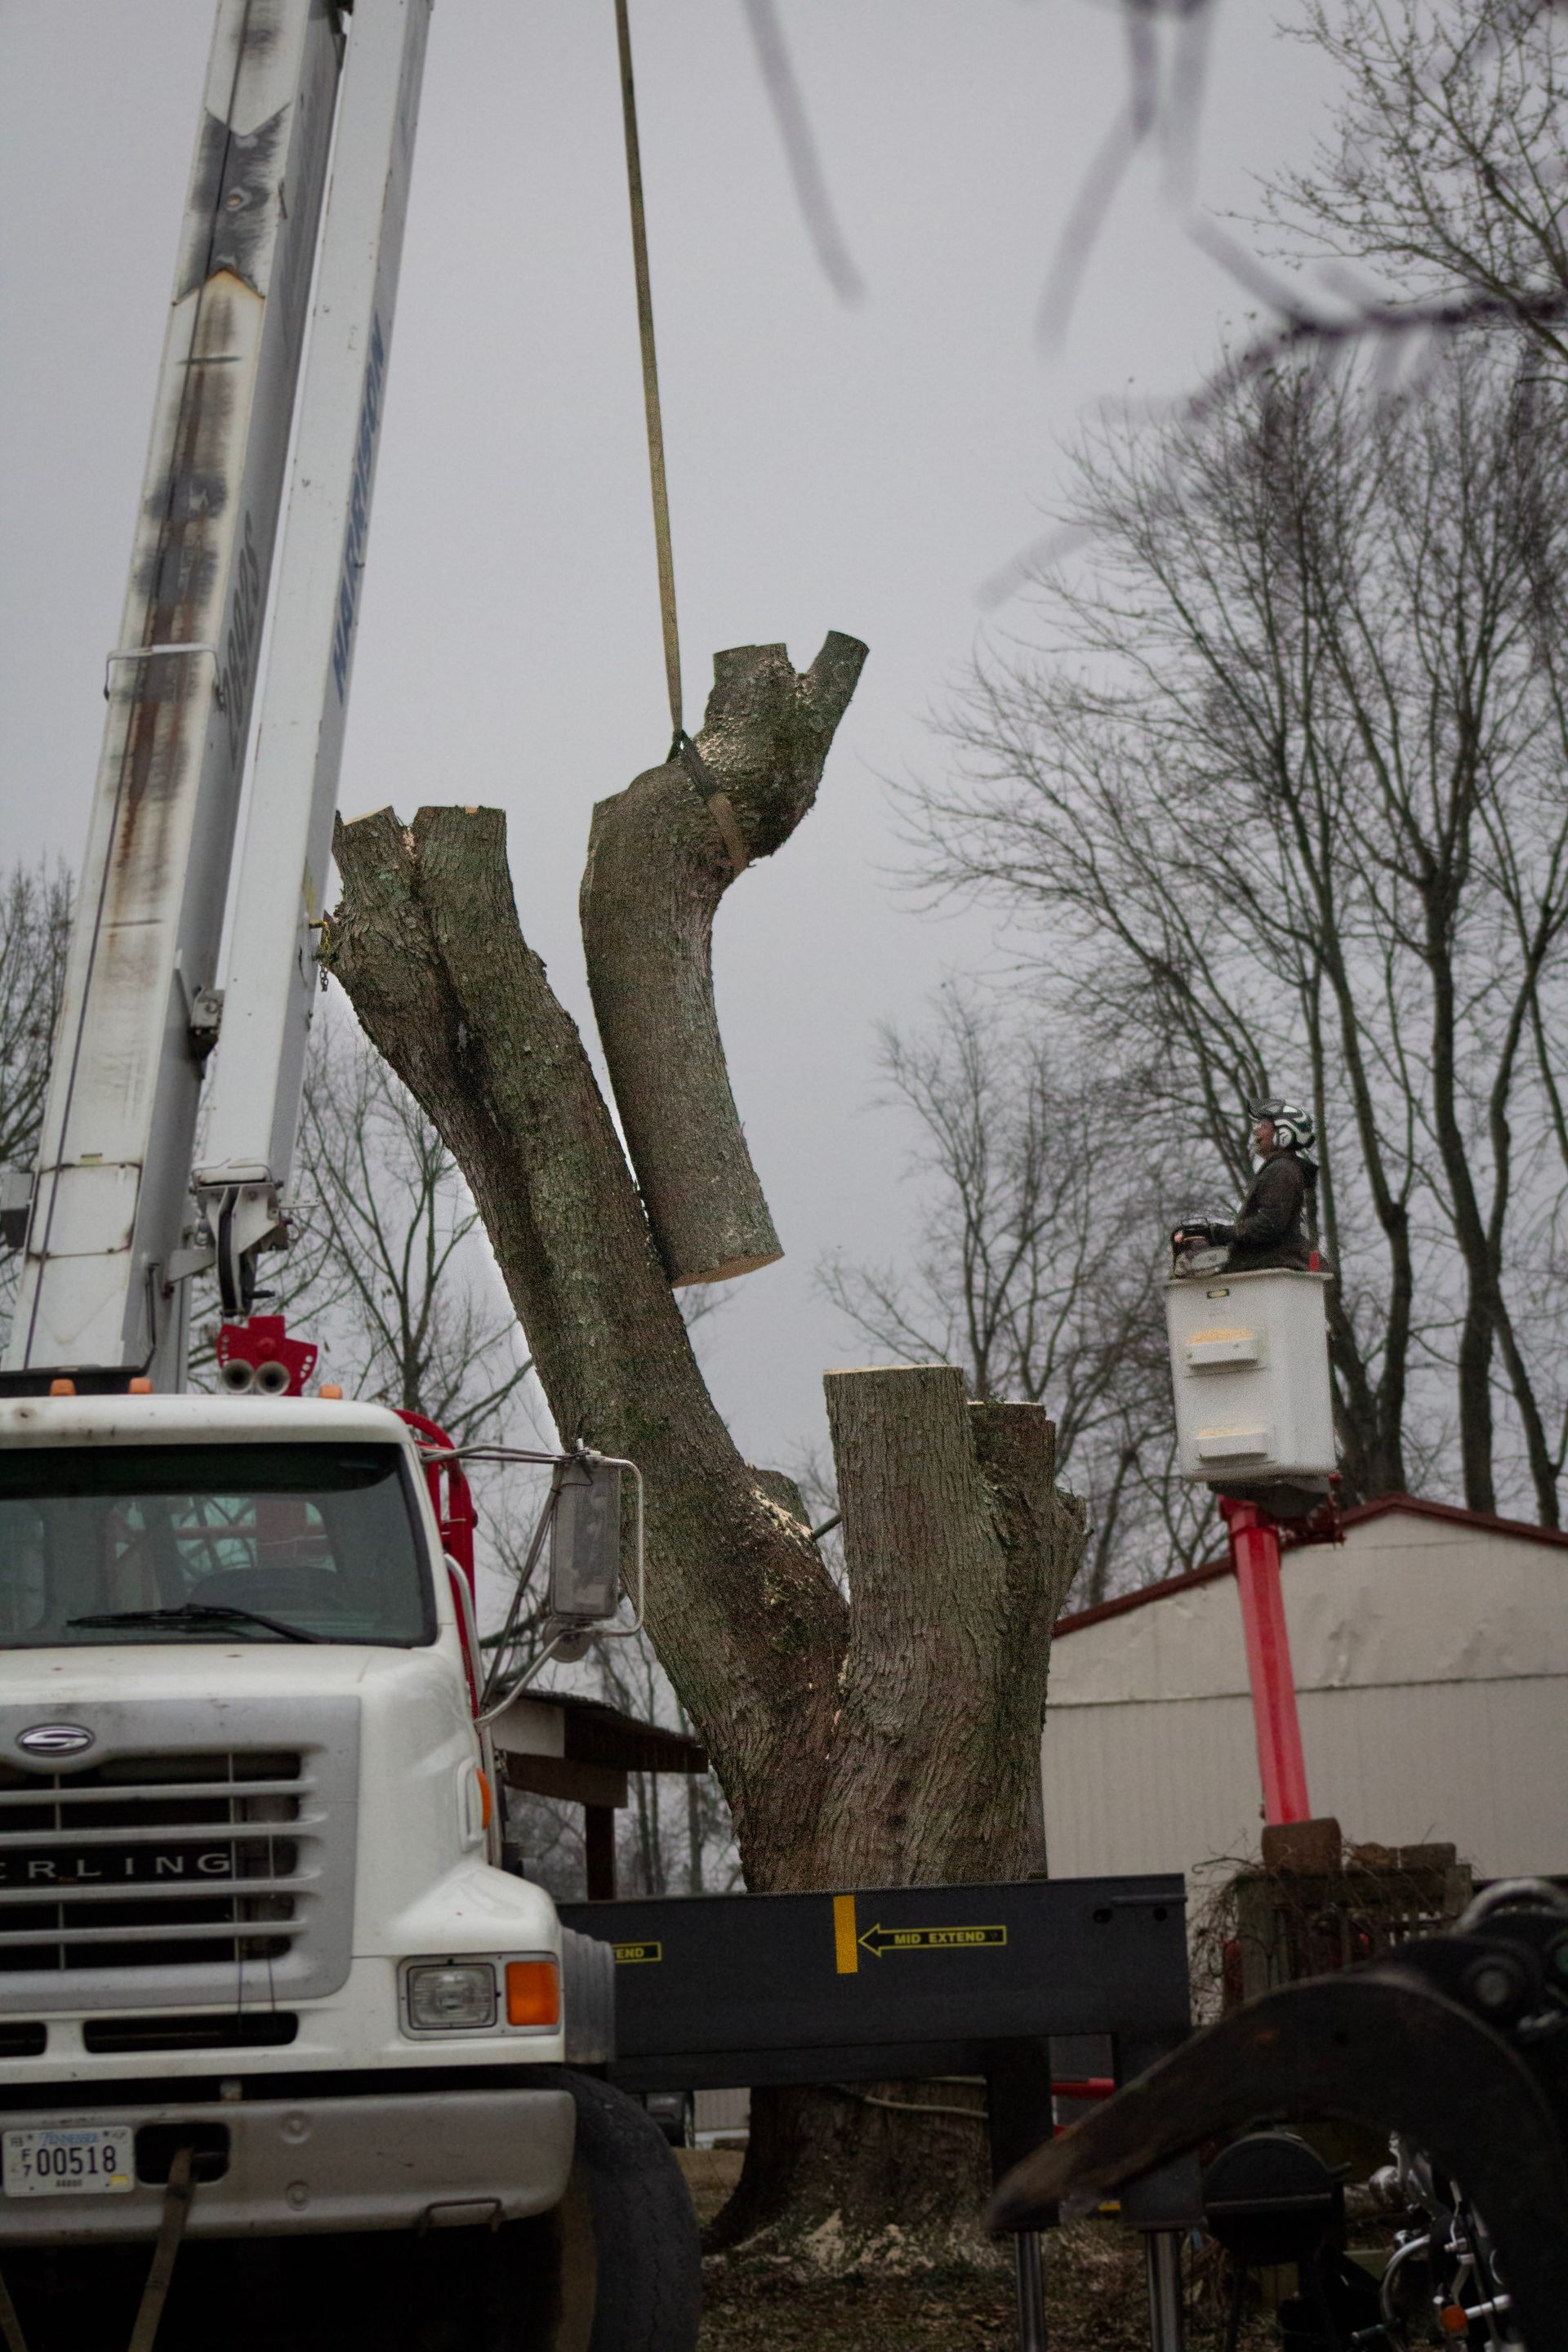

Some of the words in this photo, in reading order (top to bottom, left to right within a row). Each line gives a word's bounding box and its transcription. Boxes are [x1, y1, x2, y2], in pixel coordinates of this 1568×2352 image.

[332, 306, 385, 706] HARRISON
[893, 1932, 921, 1944] MID
[928, 1931, 986, 1944] EXTEND
[36, 2145, 117, 2176] 00518
